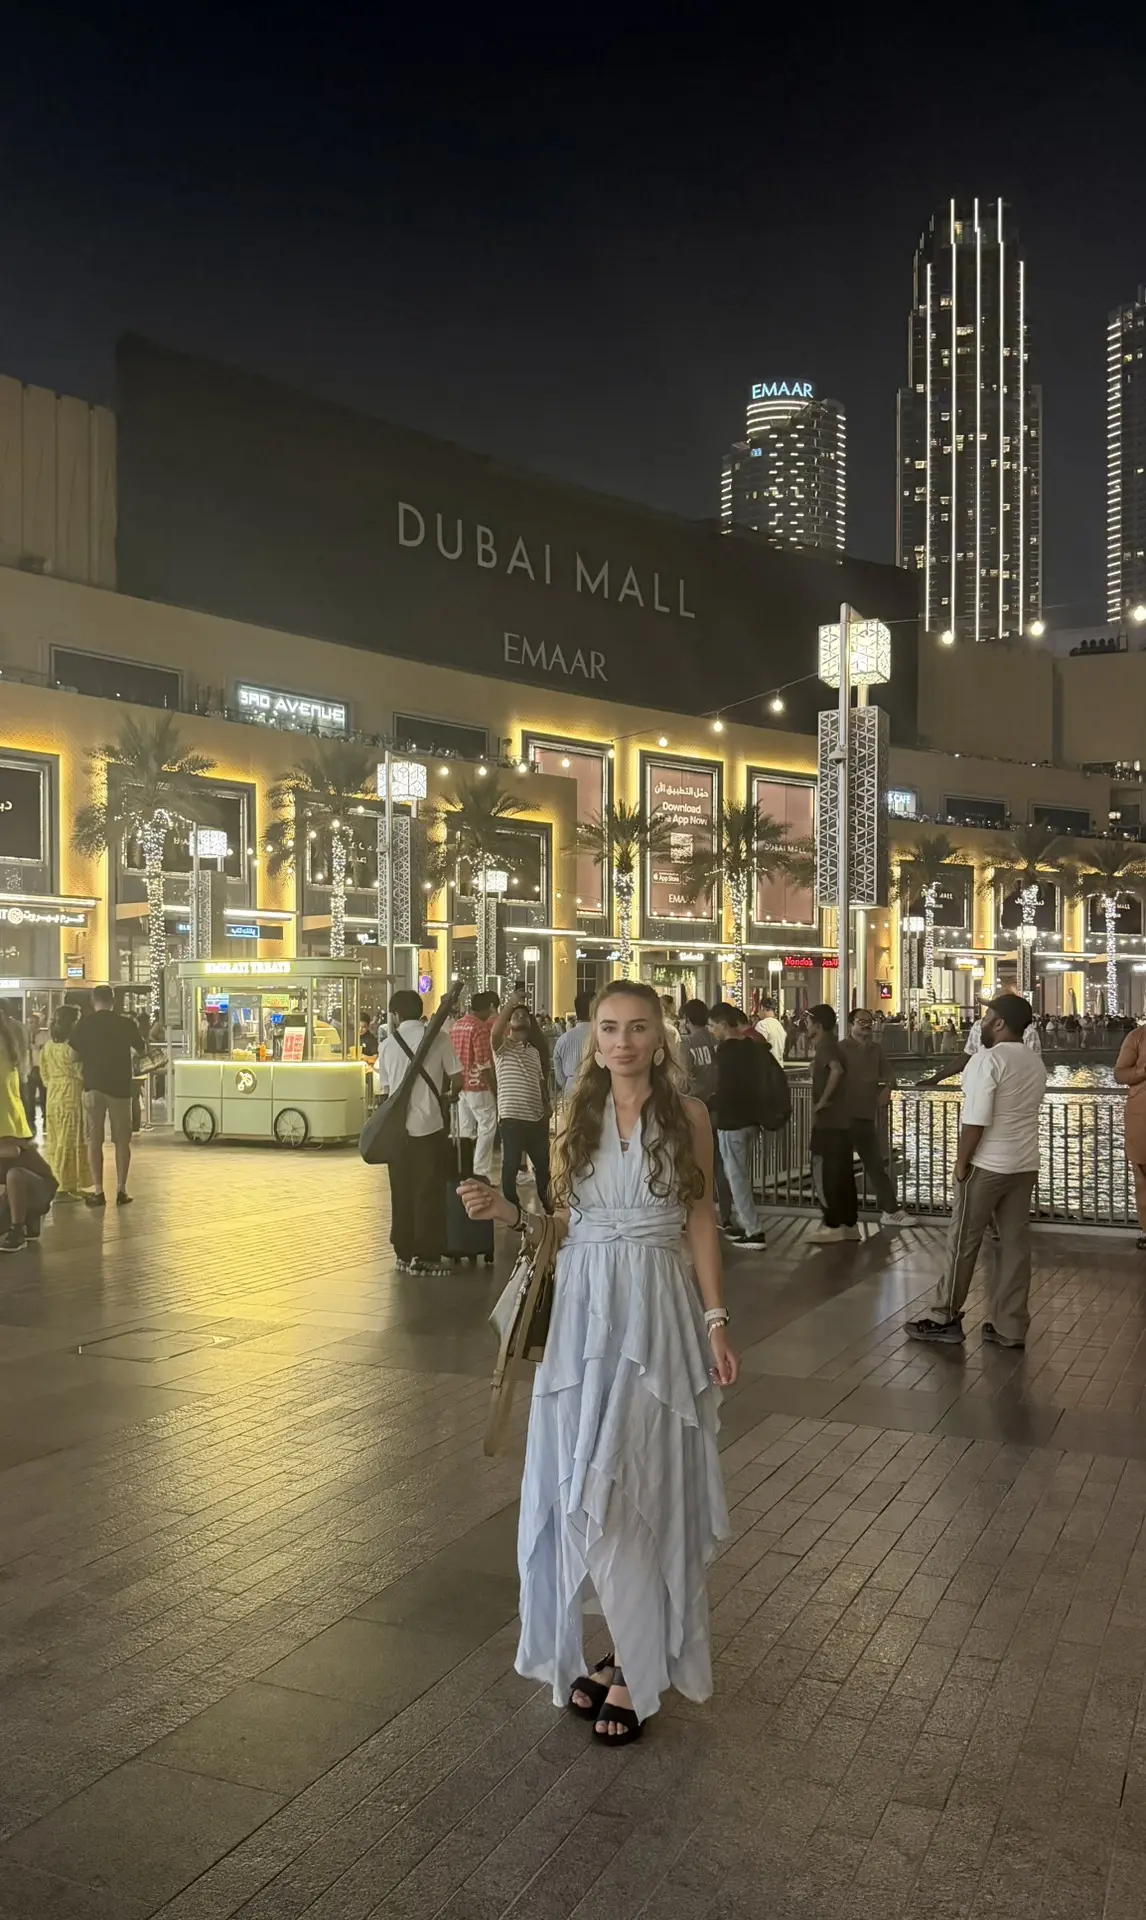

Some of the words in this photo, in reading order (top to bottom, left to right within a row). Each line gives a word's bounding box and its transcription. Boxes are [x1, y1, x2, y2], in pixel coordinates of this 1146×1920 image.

[752, 381, 814, 399] EMAAR
[397, 501, 552, 584] DUBAI
[576, 551, 696, 619] MALL
[504, 632, 609, 681] EMAAR
[275, 697, 344, 721] AVENUE
[662, 801, 701, 814] Download
[655, 812, 671, 822] Te
[672, 814, 689, 826] App
